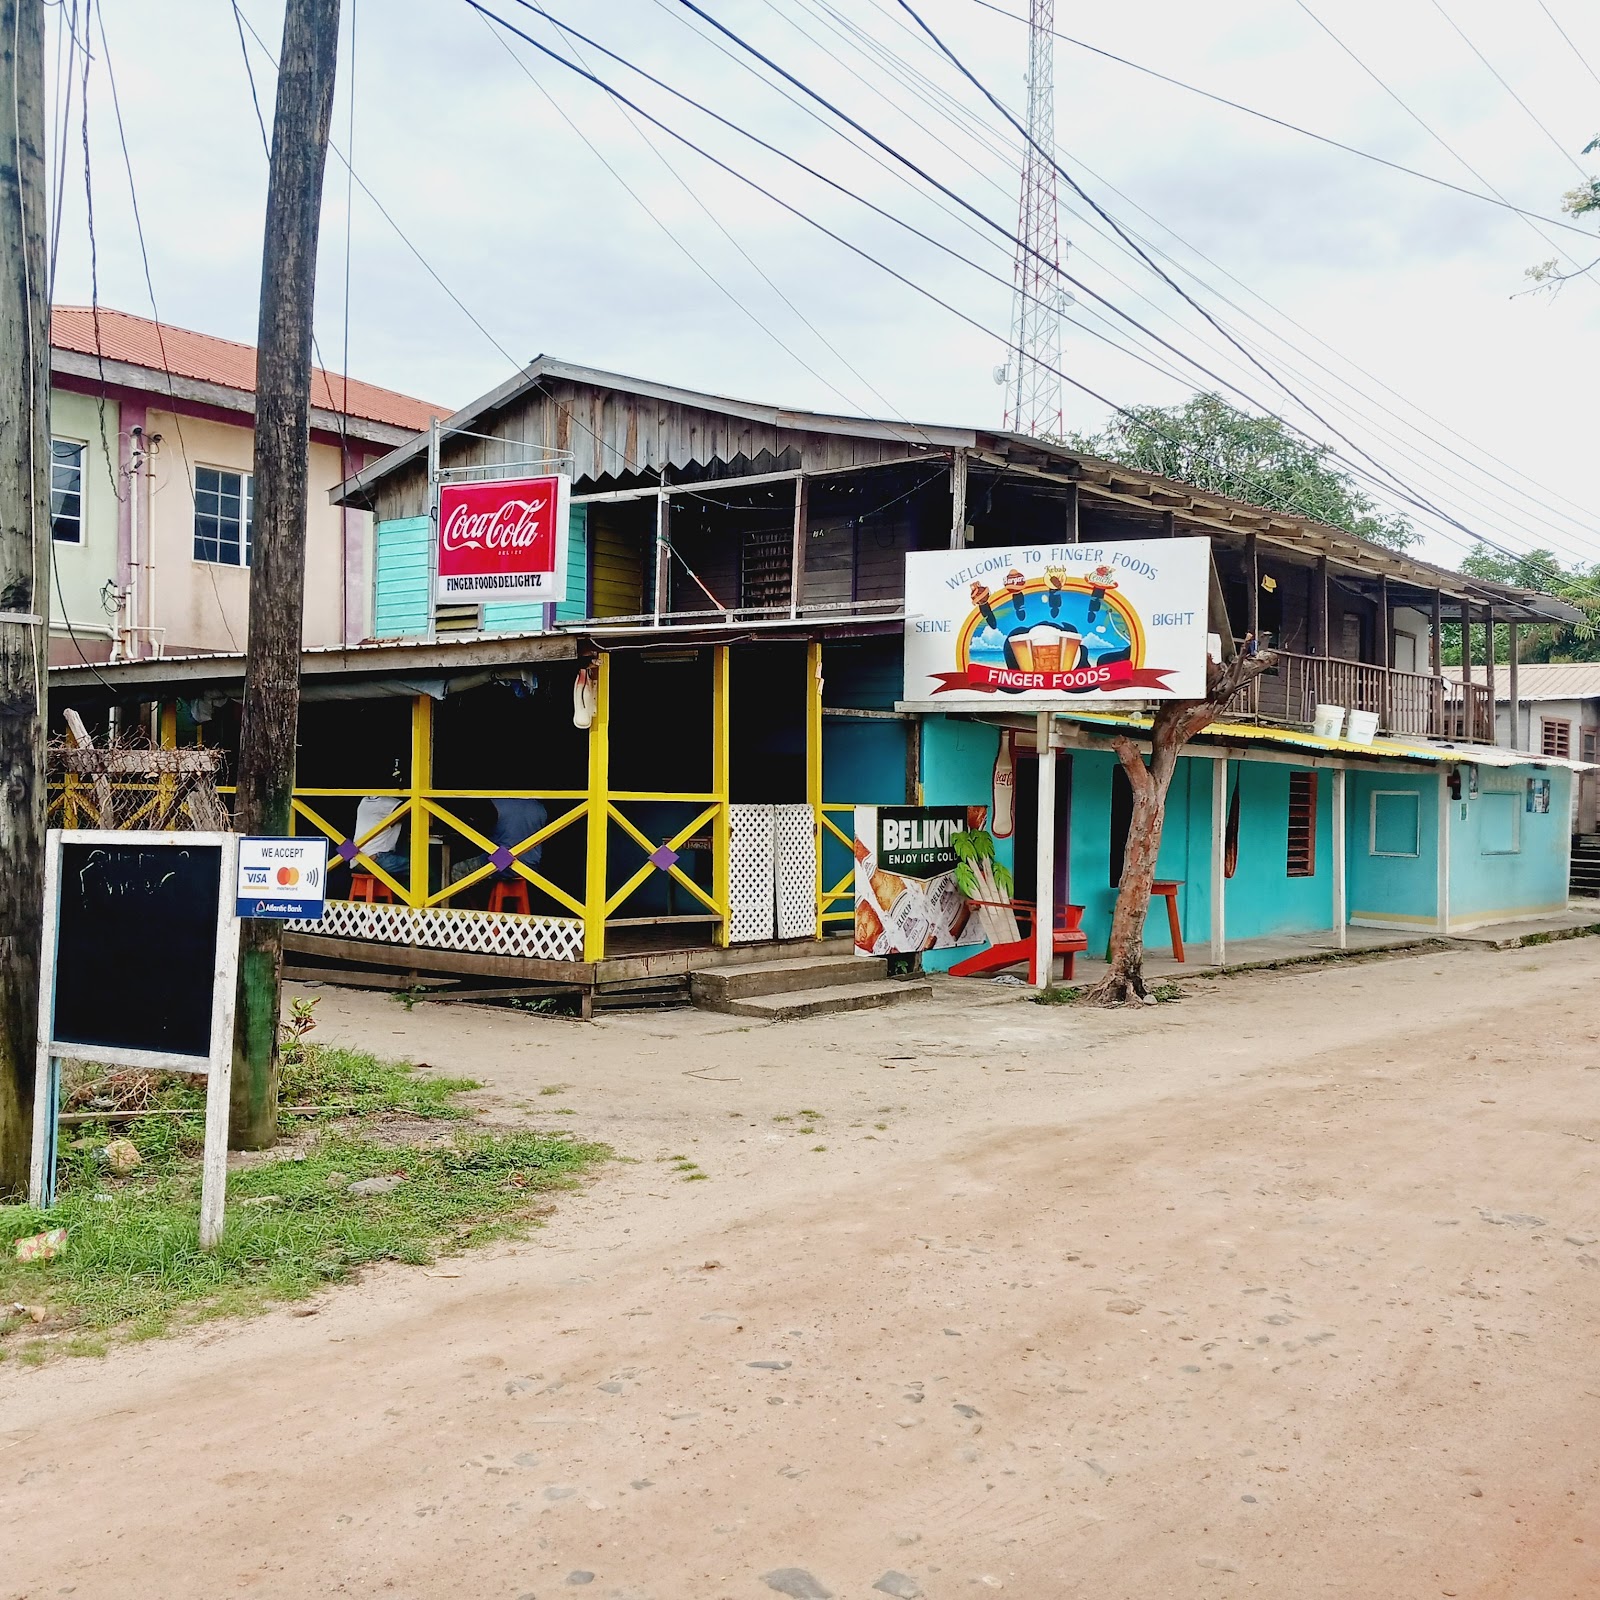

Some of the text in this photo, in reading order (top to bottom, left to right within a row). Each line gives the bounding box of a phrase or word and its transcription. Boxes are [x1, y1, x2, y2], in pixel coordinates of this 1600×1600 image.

[945, 548, 1159, 590] WELCOME TO FINGER FOODS
[1044, 565, 1066, 573] Kebab
[447, 574, 542, 591] FINGER FOODS DELIGHTZ
[1152, 612, 1194, 626] BIGHT
[915, 620, 951, 633] SEINE
[987, 668, 1111, 688] FINGER FOODS
[261, 848, 304, 858] WE ACCEPT
[888, 854, 917, 865] ENJOY
[920, 853, 934, 863] ICE
[246, 873, 267, 883] VISA
[265, 903, 303, 913] Atlantic Bank
[896, 901, 913, 931] ELIKI
